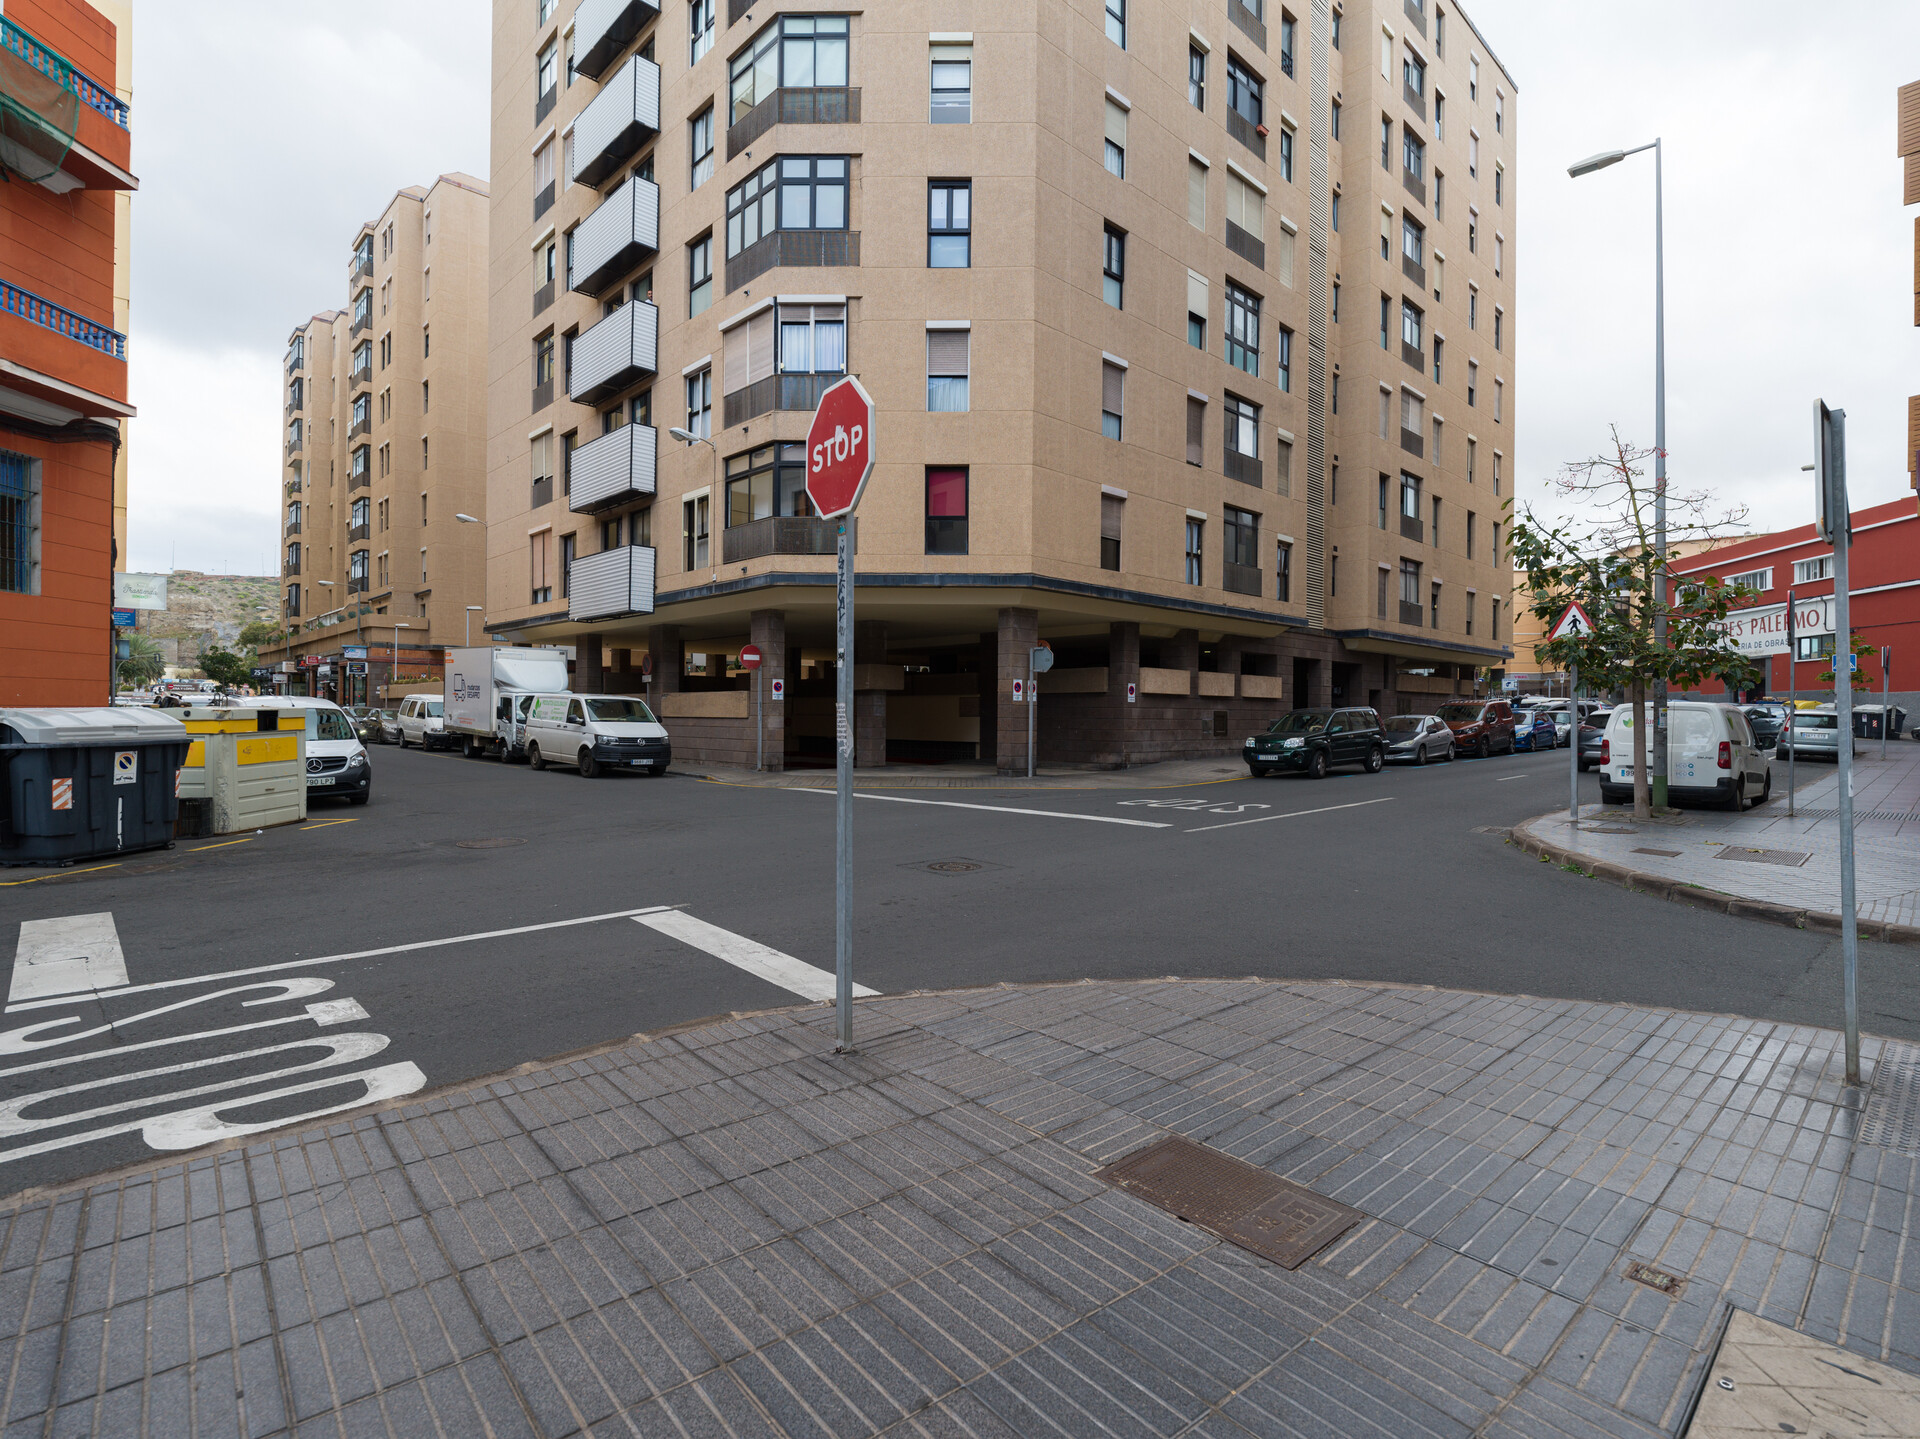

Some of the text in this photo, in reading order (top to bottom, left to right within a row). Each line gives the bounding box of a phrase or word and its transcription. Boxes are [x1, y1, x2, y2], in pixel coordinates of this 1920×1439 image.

[812, 424, 864, 474] STOP
[1754, 641, 1763, 649] DE
[1116, 798, 1272, 813] STOP
[0, 976, 427, 1163] STOP
